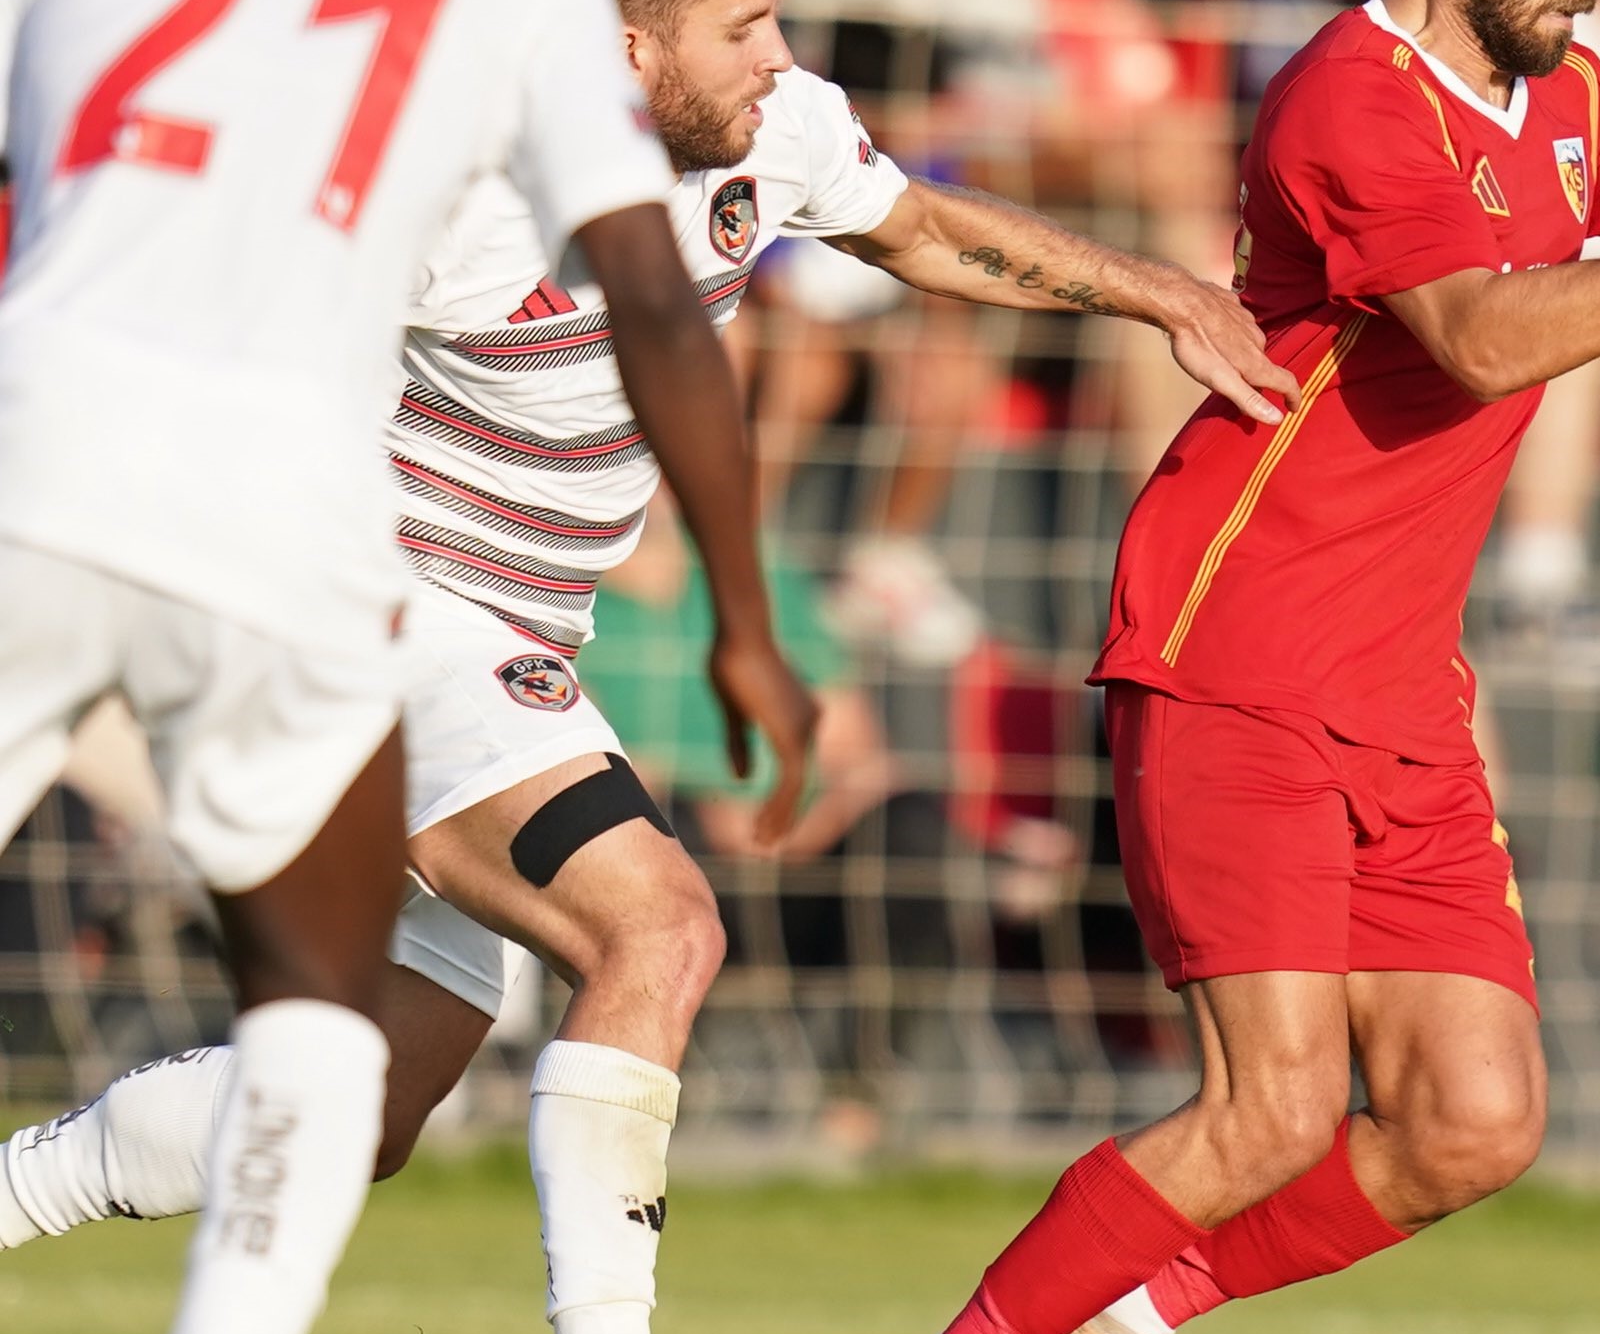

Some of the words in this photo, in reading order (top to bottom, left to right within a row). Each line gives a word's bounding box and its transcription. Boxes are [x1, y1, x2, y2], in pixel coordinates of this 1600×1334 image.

[1563, 167, 1584, 192] KS
[722, 183, 745, 202] GFK
[512, 659, 548, 674] GFK
